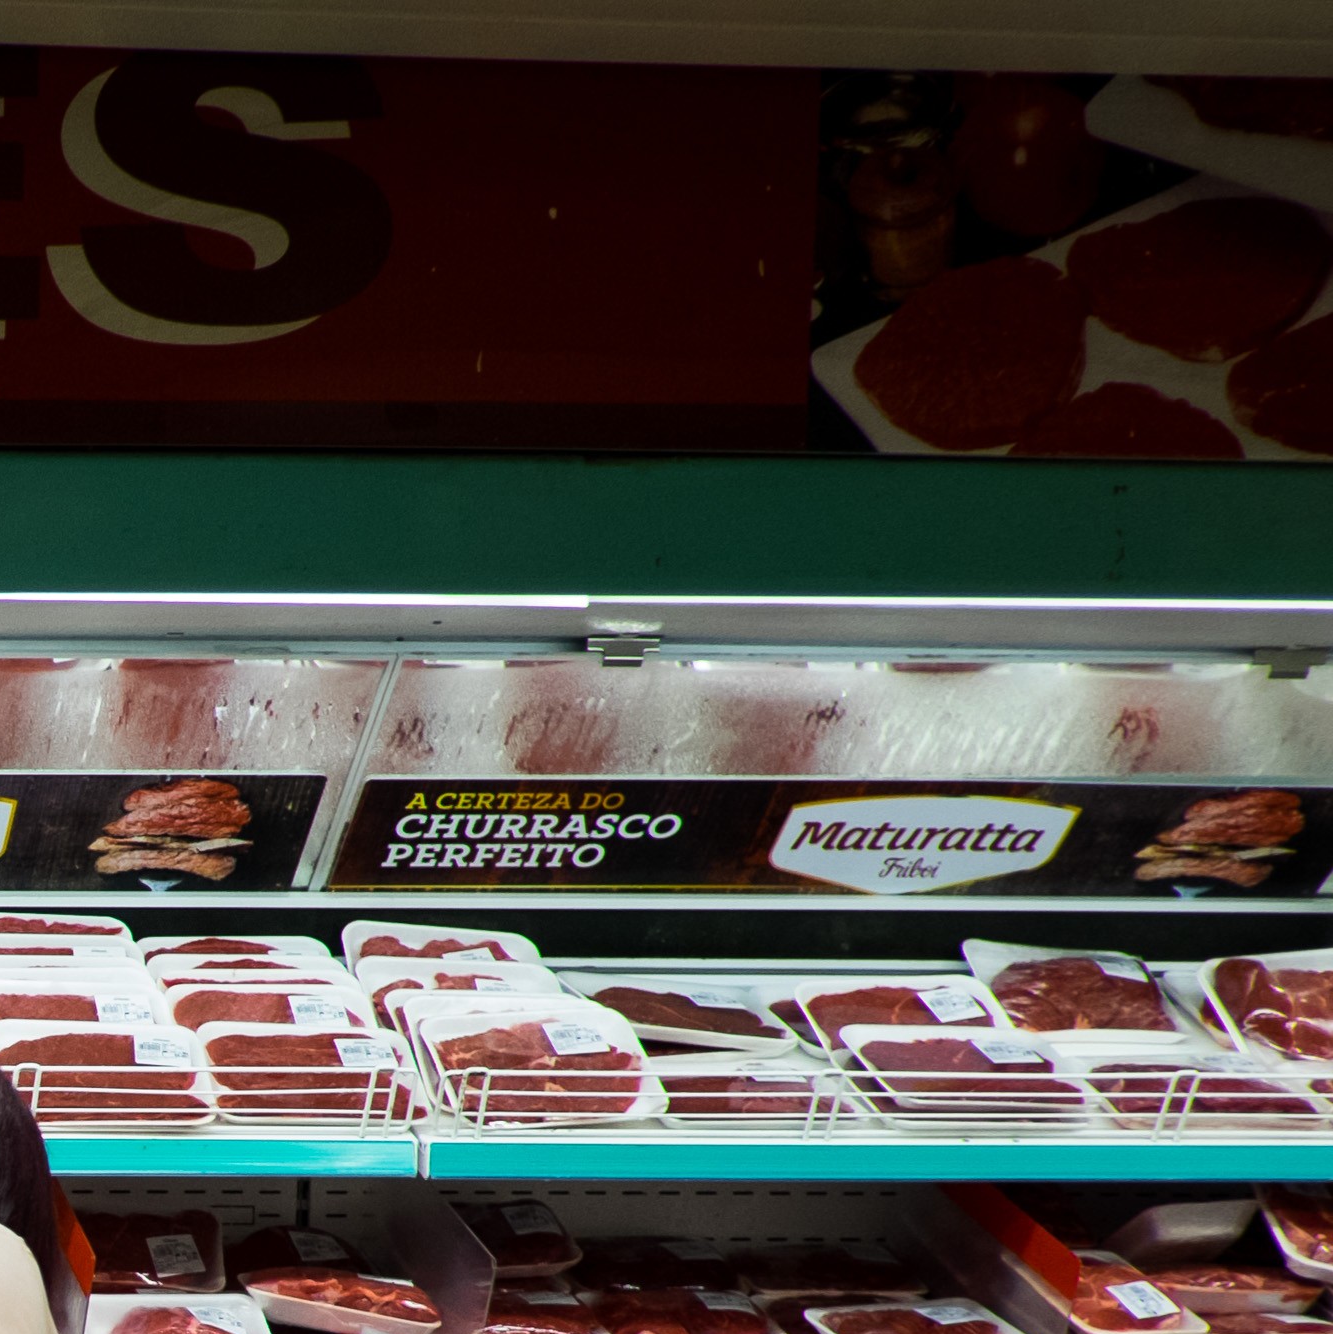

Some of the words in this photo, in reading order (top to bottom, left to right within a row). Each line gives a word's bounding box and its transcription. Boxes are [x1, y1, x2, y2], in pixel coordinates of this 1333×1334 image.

[405, 793, 428, 810] A
[436, 793, 572, 810] CERTEZA
[579, 793, 625, 810] DO
[395, 813, 683, 840] CHURRASCO
[791, 821, 1046, 853] Maturatta
[381, 843, 606, 869] PERFEITO
[878, 857, 942, 879] Friboi
